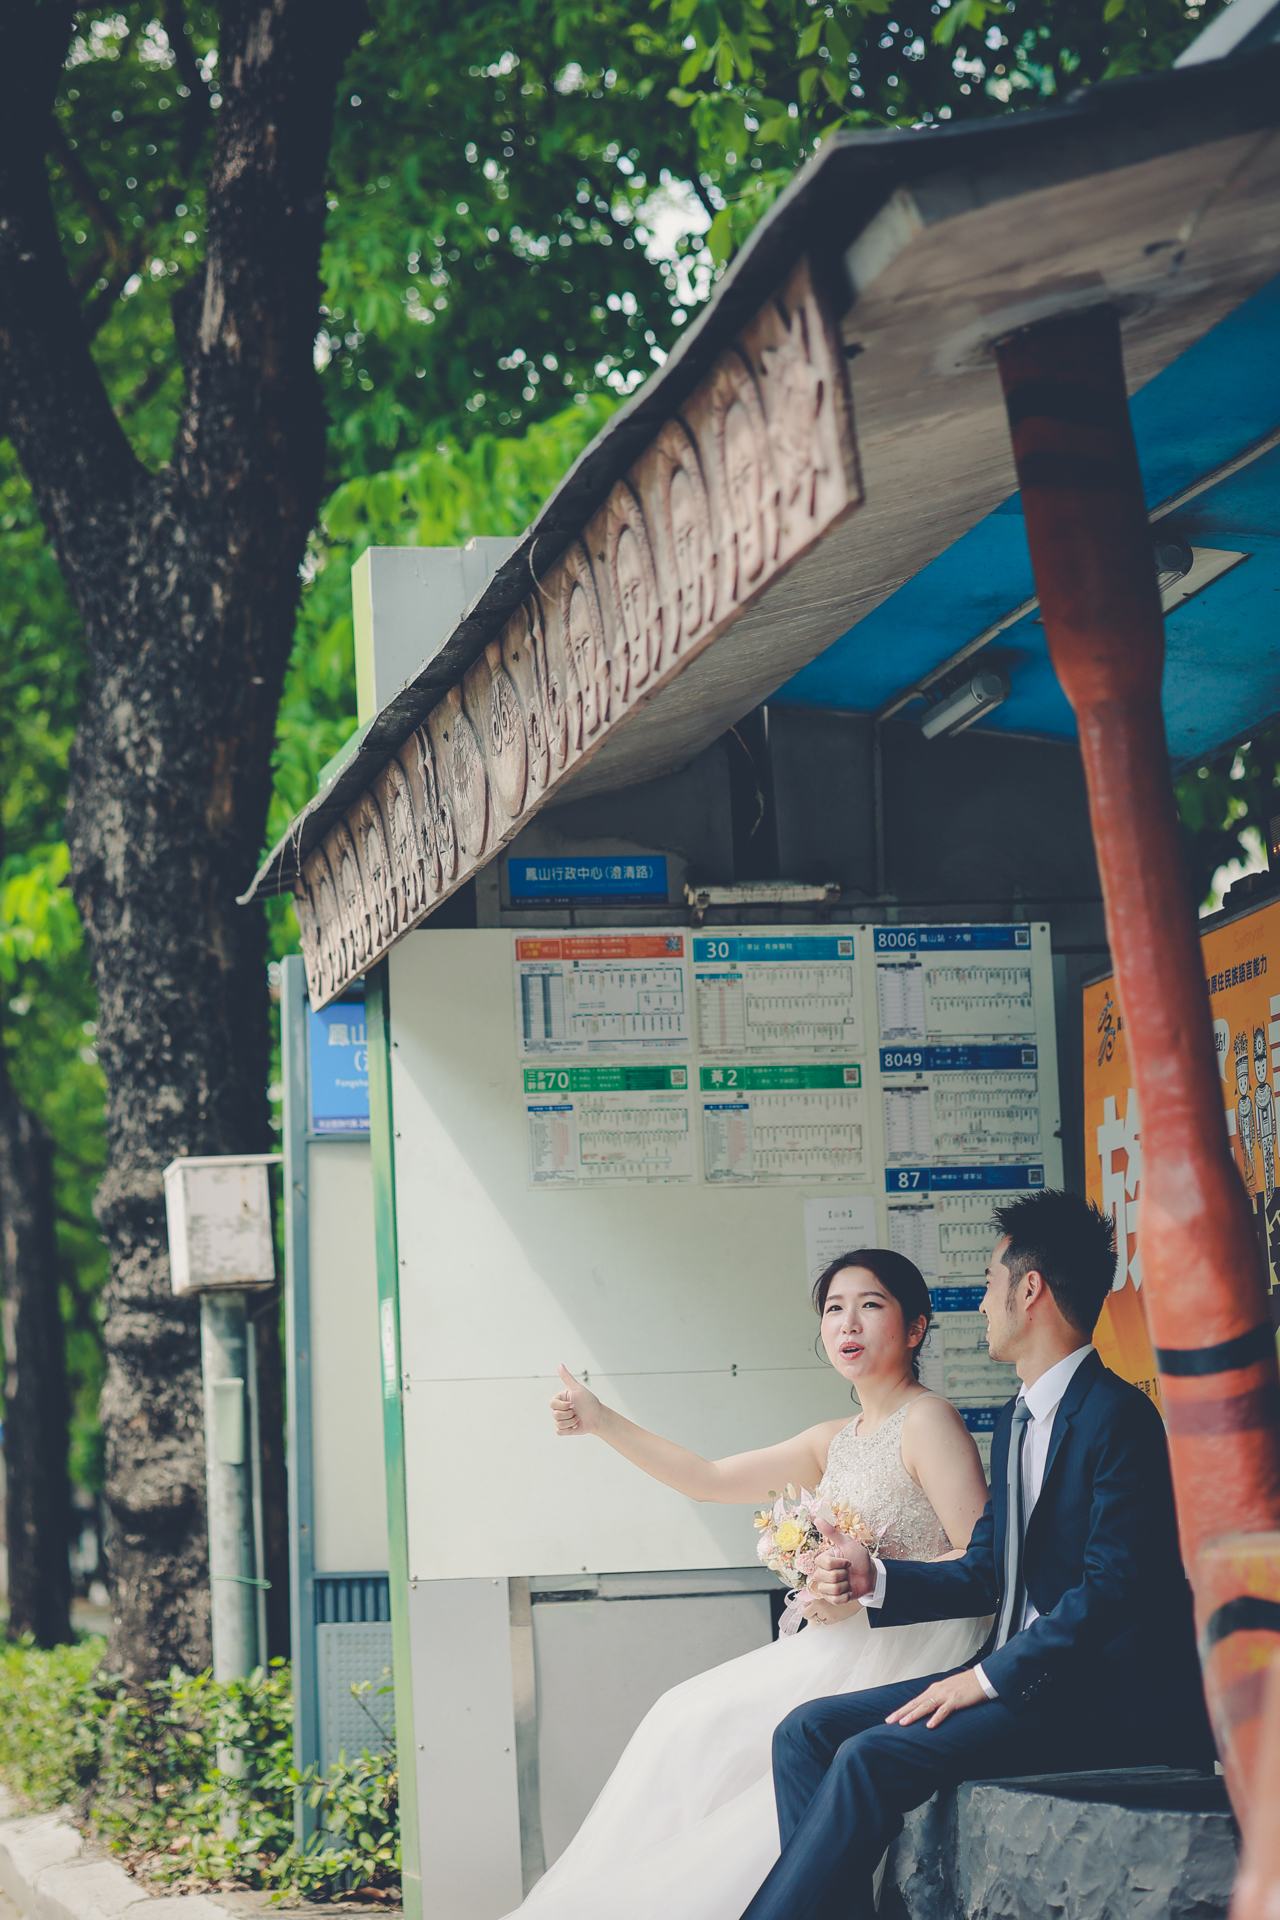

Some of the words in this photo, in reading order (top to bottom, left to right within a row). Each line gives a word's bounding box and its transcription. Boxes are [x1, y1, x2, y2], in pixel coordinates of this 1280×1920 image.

[525, 866, 654, 881] 鳳山行政中心(澄清路)
[878, 932, 917, 947] 8006
[706, 942, 729, 958] 30
[884, 1053, 922, 1067] 8049
[546, 1072, 569, 1088] 70
[898, 1171, 920, 1188] 87
